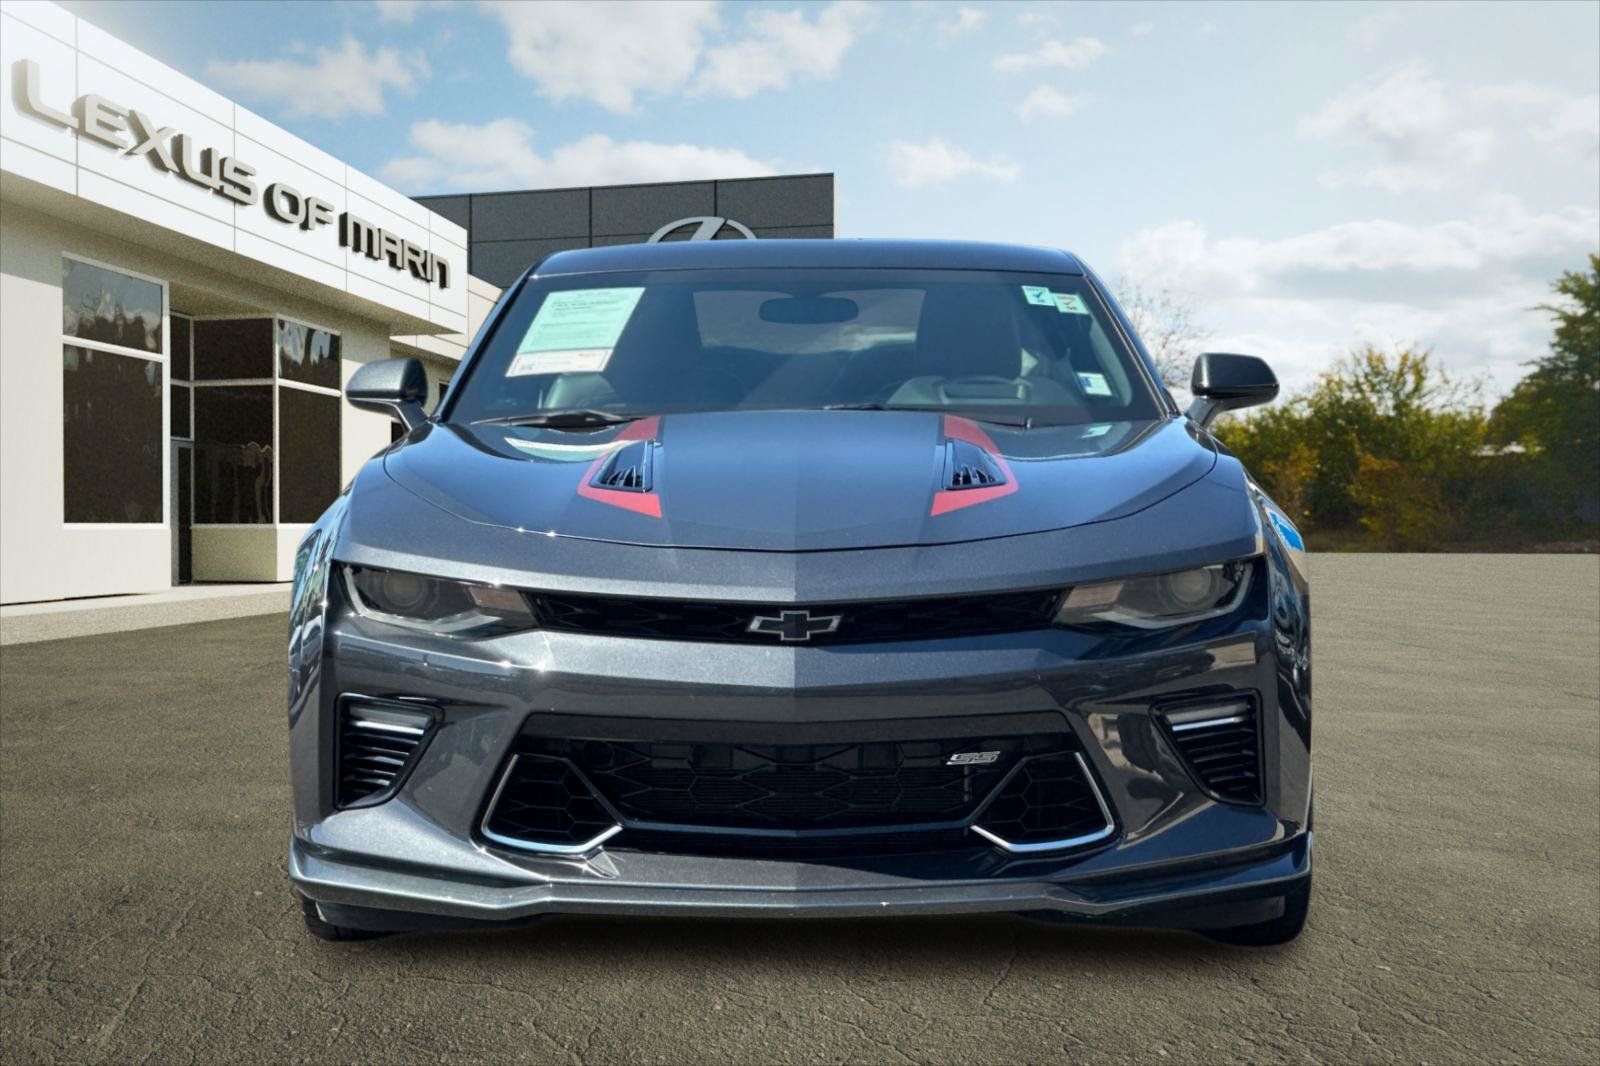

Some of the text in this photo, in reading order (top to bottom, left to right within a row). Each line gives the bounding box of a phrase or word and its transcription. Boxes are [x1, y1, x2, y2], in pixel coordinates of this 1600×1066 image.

[12, 58, 450, 289] LEXUS OF MARIN
[946, 751, 1001, 765] SS
